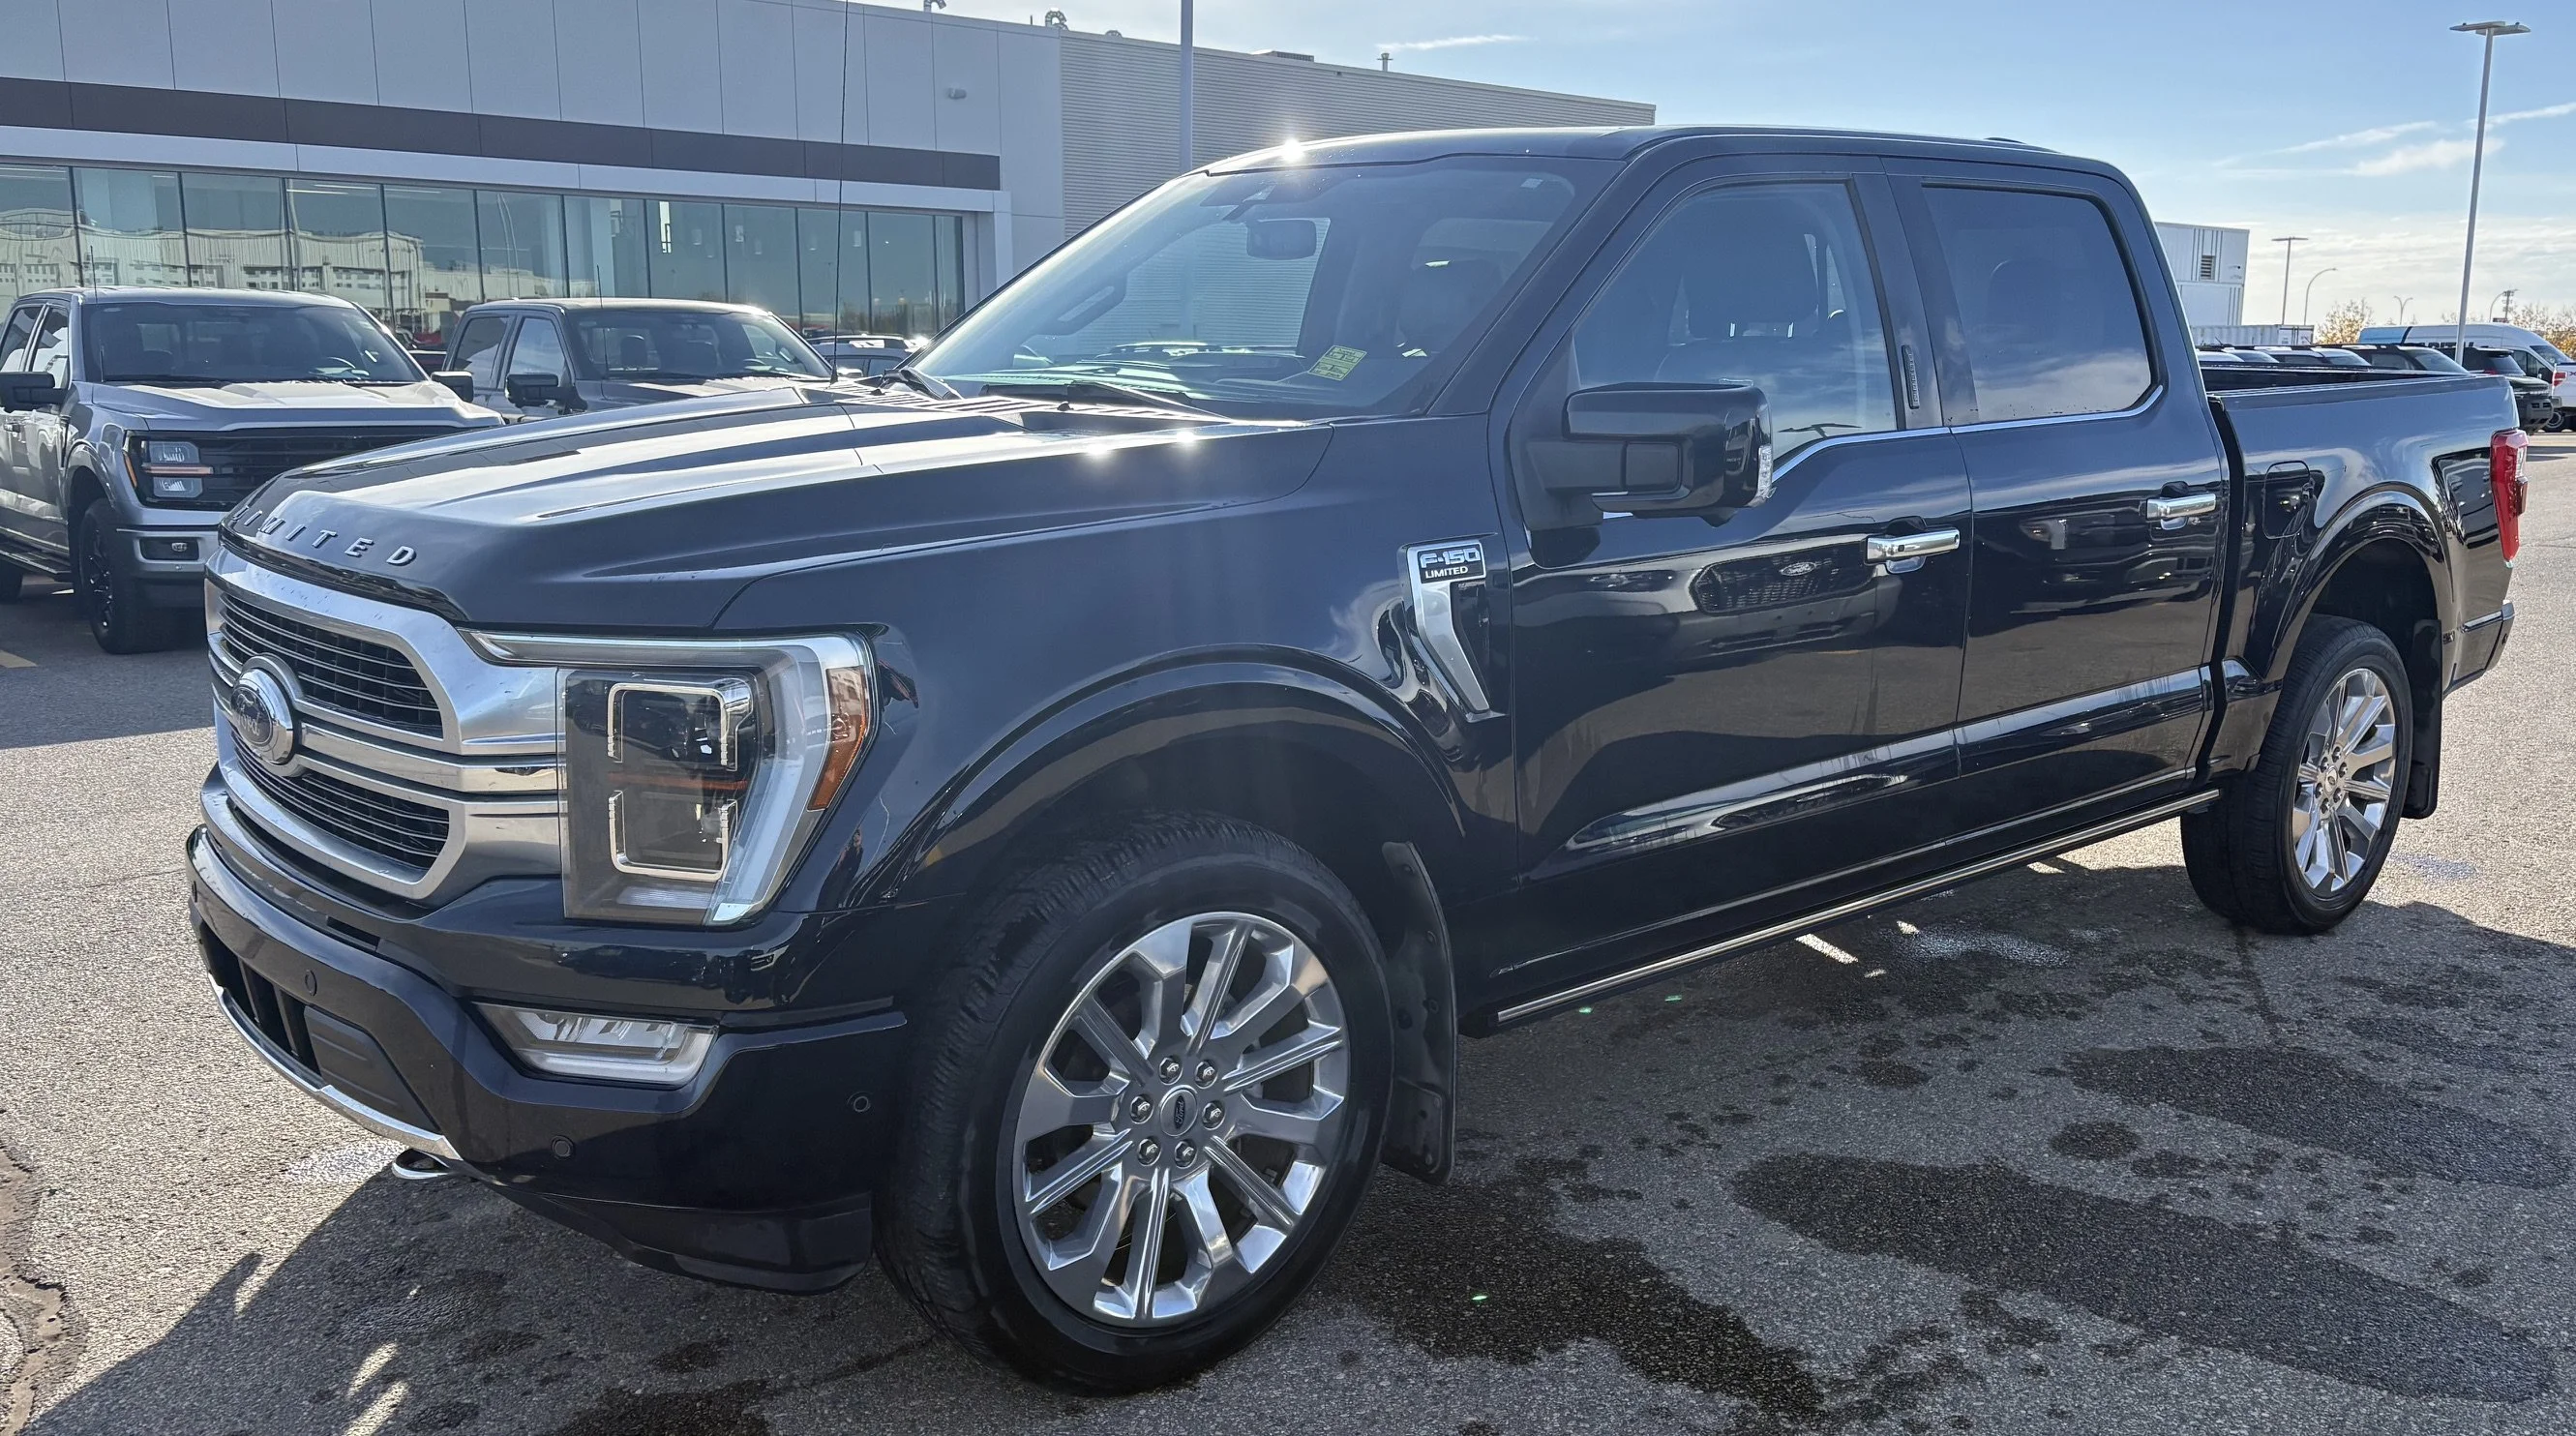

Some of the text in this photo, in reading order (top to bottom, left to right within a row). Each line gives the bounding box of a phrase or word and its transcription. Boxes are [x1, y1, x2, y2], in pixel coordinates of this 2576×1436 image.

[232, 504, 416, 565] LIMITED
[1420, 547, 1482, 569] F-150
[1425, 566, 1469, 579] LIMITED
[236, 693, 260, 736] Ford
[1174, 1100, 1184, 1124] Ford
